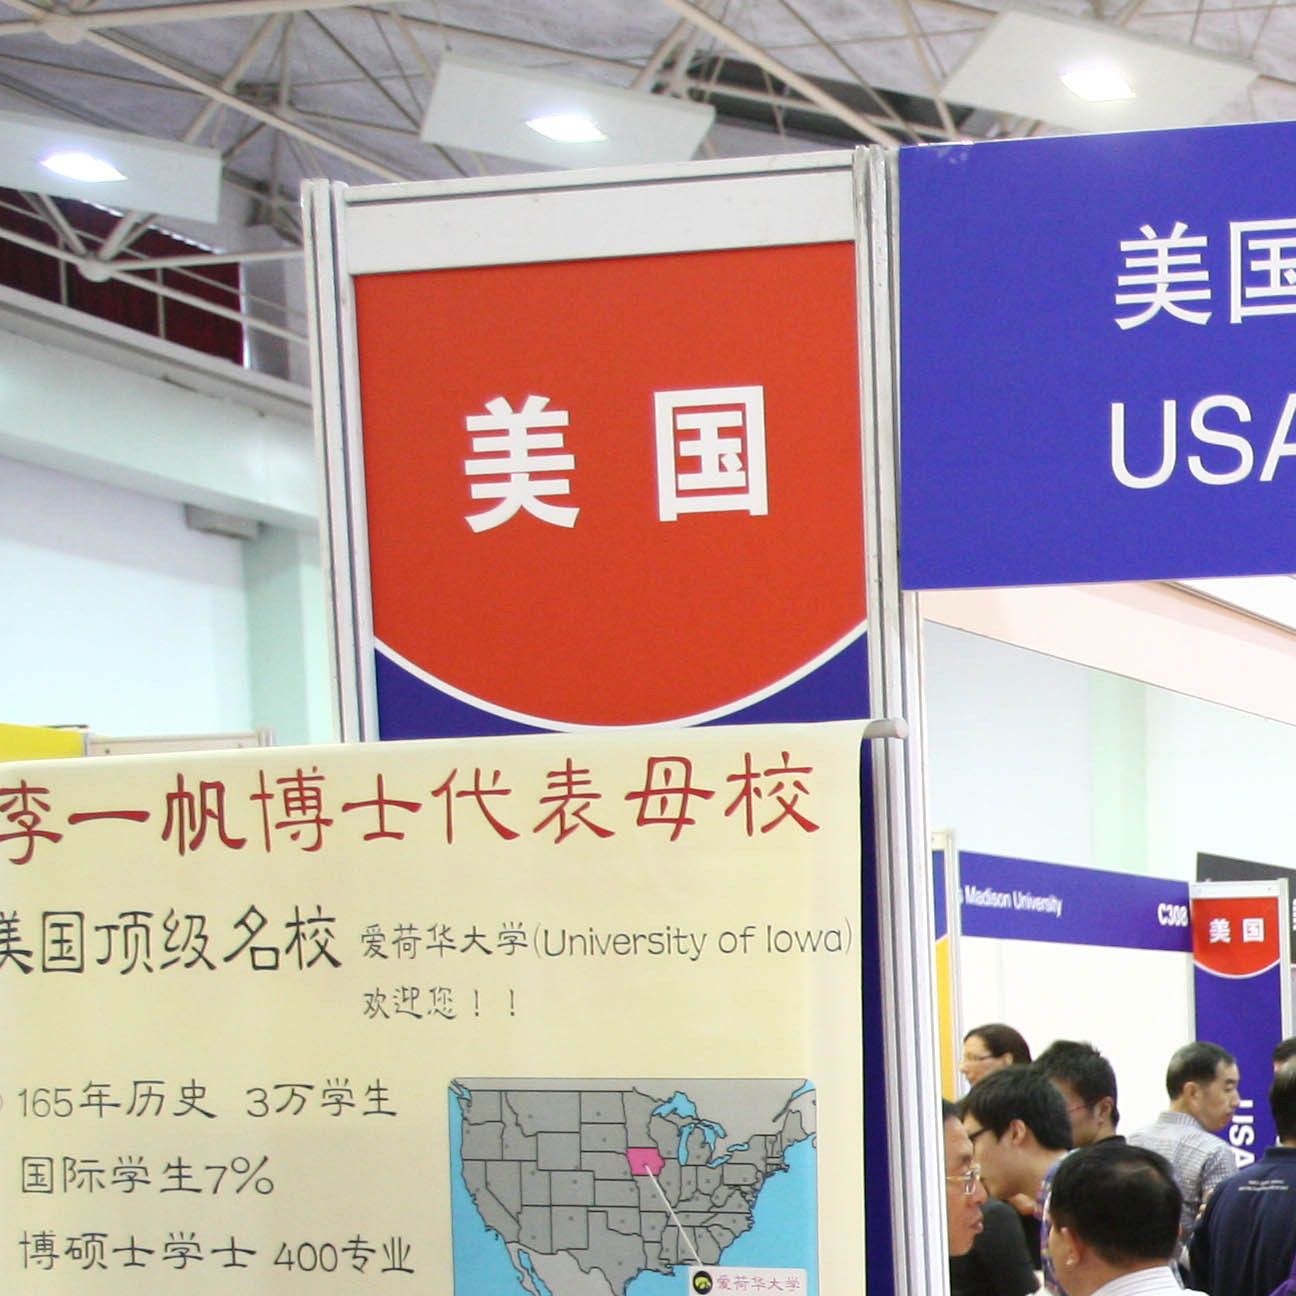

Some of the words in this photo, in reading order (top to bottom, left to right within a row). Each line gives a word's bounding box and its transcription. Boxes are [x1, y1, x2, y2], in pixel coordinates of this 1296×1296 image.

[463, 385, 768, 534] 美国
[0, 750, 822, 867] 李一帆博士代表母校
[965, 884, 1012, 911] Madison
[1013, 891, 1063, 918] University
[718, 923, 757, 956] of
[764, 916, 853, 960] Iowa)
[1208, 916, 1266, 944] 美国
[17, 1079, 217, 1121] 165年历史
[244, 1077, 399, 1120] 3万学生
[20, 1154, 276, 1197] 国际学生7%
[18, 1231, 258, 1272] 博硕士学士
[273, 1235, 416, 1276] 400专业
[715, 1274, 801, 1292] 爱荷华大学
